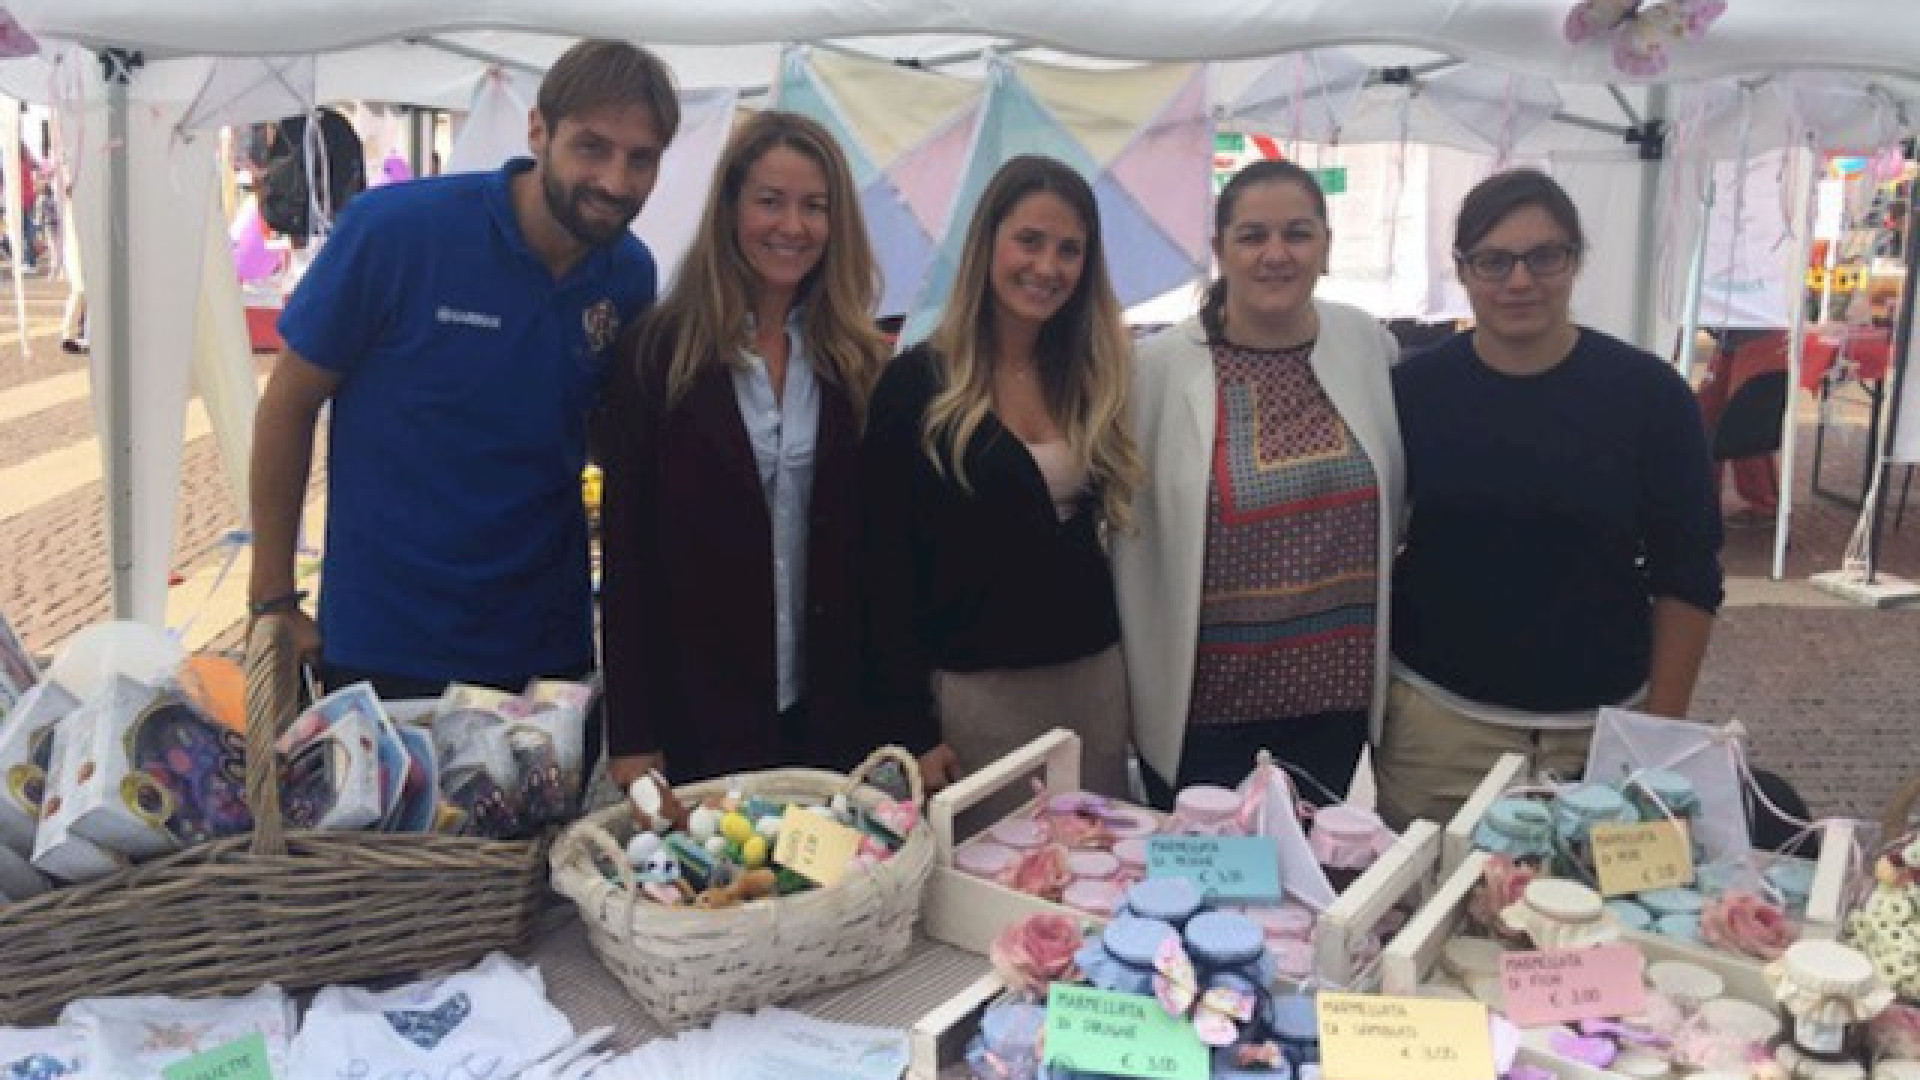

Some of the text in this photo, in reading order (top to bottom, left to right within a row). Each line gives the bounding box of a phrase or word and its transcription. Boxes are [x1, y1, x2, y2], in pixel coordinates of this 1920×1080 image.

[1505, 953, 1584, 971] MARMELLATA
[1056, 991, 1147, 1020] MARMELLATA
[1321, 1001, 1409, 1018] MARMELLATA
[1056, 1015, 1071, 1031] DI
